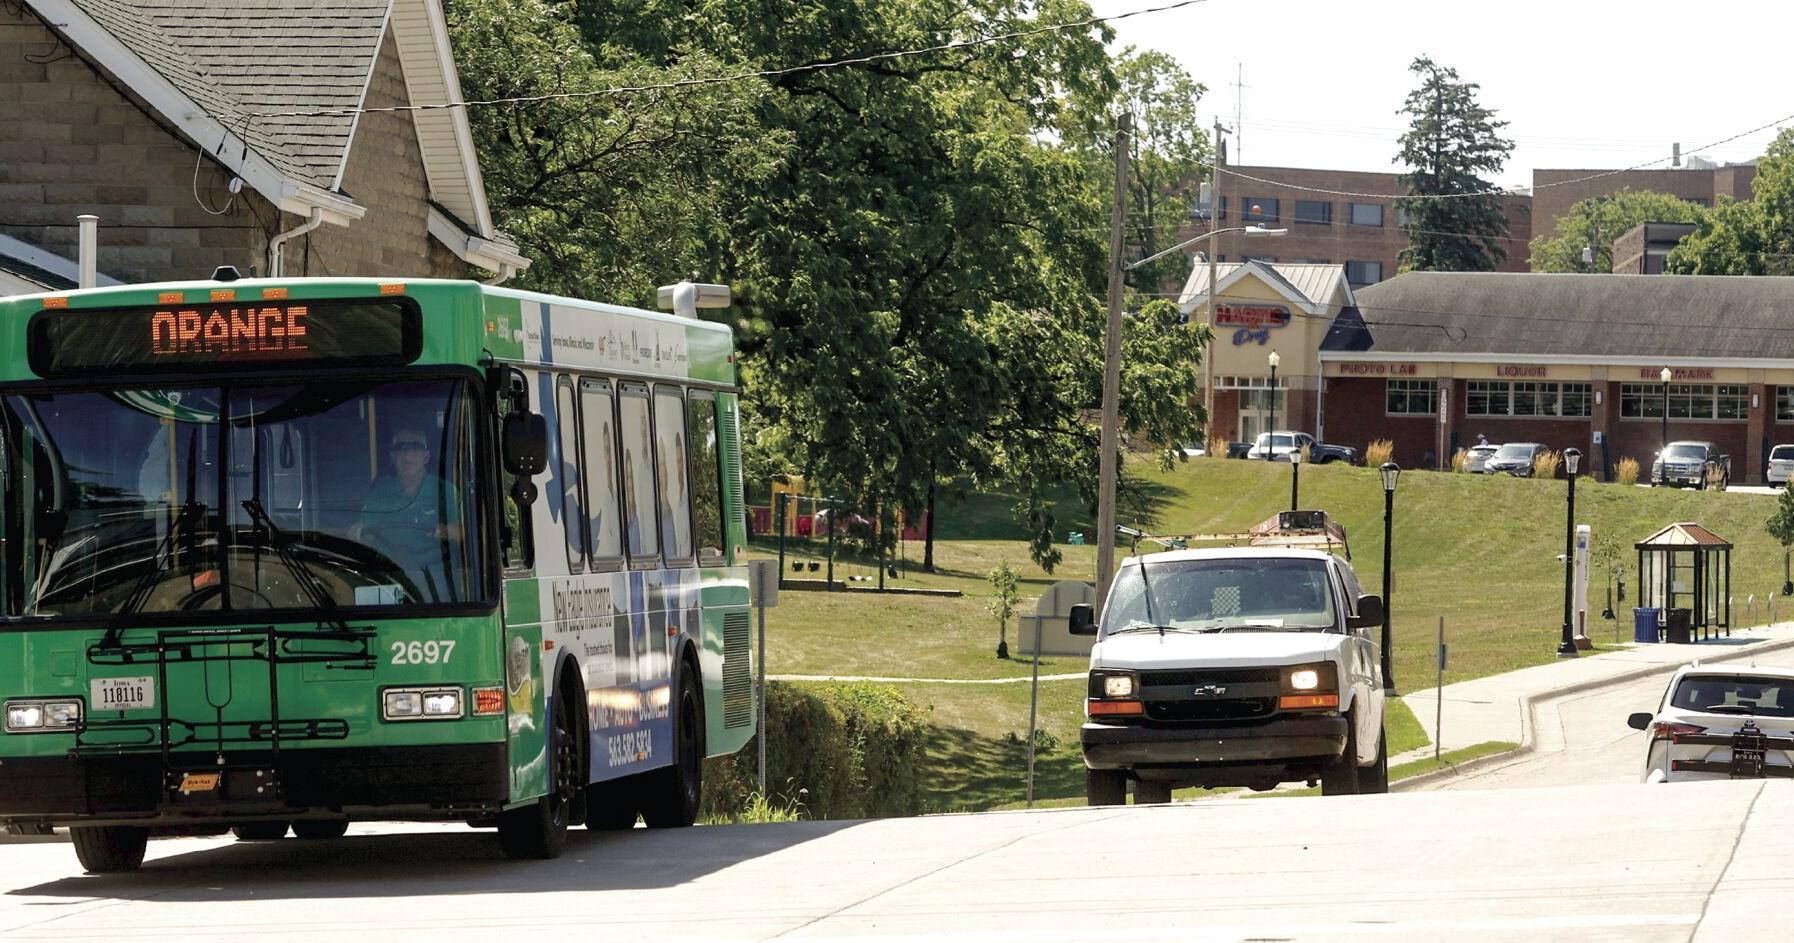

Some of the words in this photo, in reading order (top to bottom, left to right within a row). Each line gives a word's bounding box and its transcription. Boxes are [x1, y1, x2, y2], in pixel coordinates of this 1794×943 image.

[152, 306, 308, 354] ORANGE
[1340, 363, 1385, 375] PHOTO
[1390, 364, 1416, 375] LAB
[1496, 366, 1546, 377] LIQUOR
[1641, 367, 1713, 379] HAMARK
[552, 580, 568, 634] New
[583, 579, 612, 631] Insurance
[391, 640, 456, 665] 2697
[103, 686, 143, 703] 118116
[589, 697, 609, 731] HOME
[639, 687, 669, 721] BUSINESS
